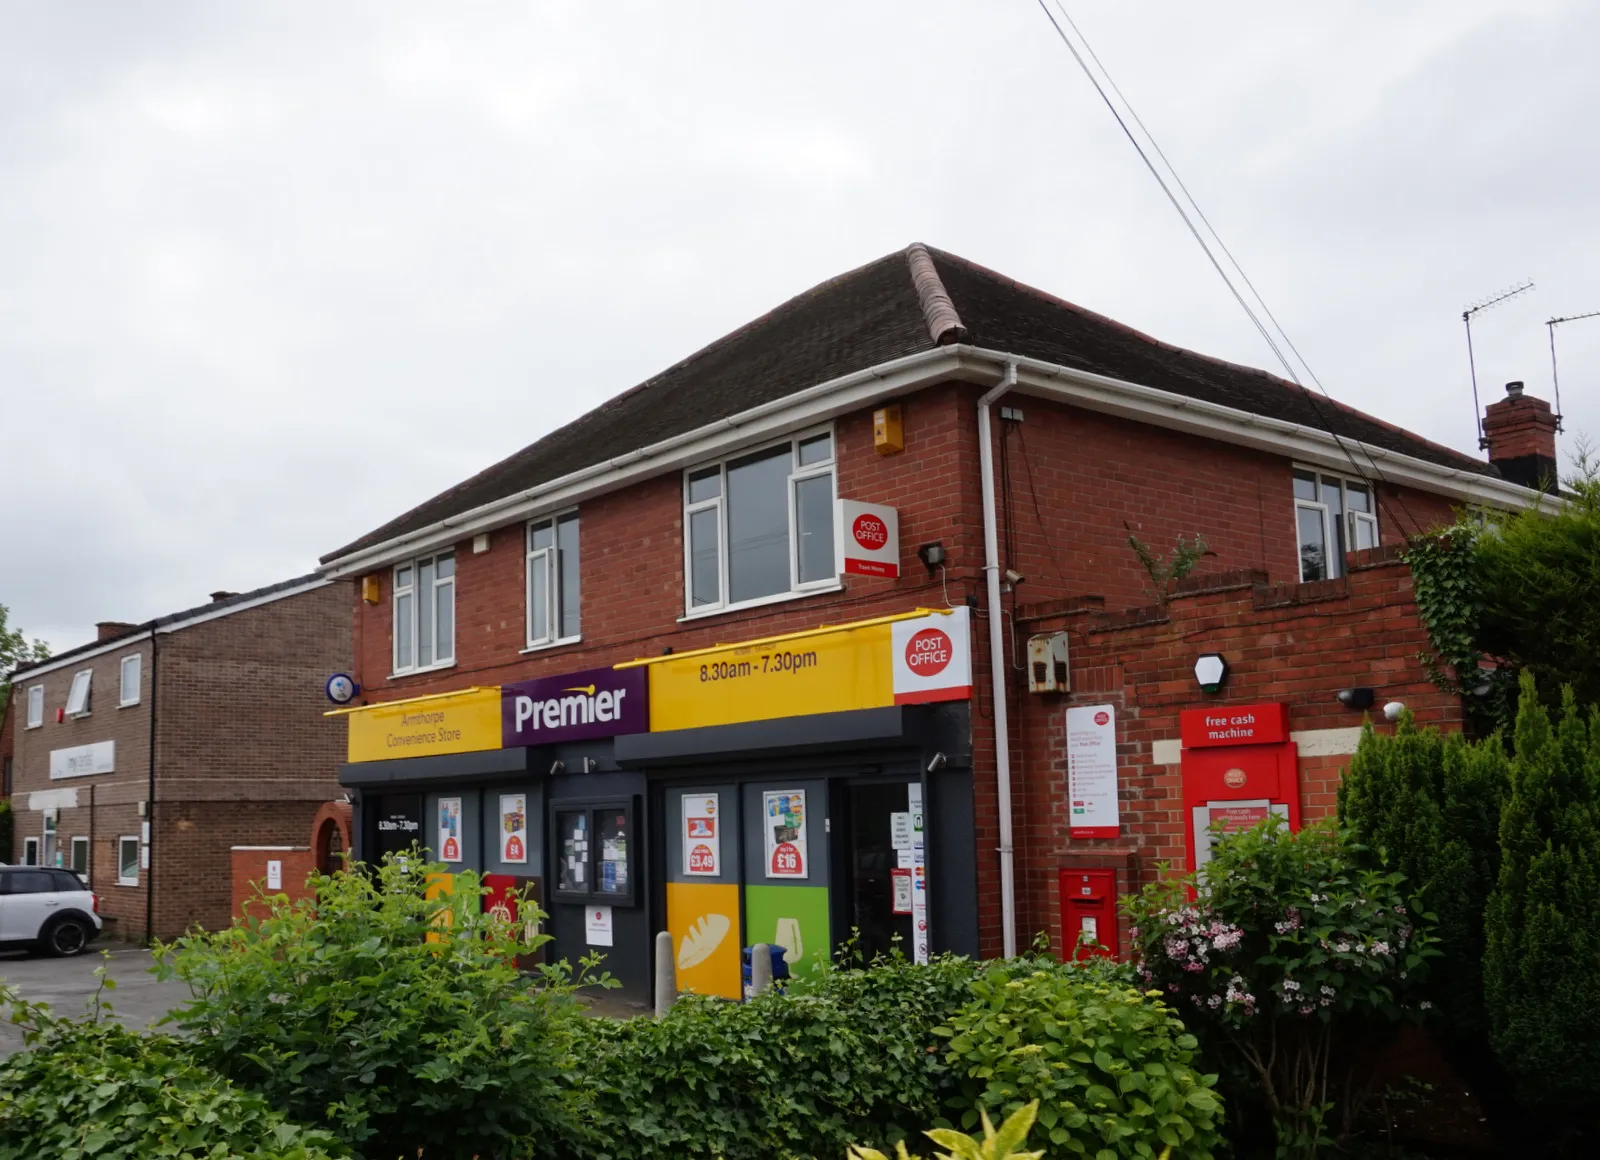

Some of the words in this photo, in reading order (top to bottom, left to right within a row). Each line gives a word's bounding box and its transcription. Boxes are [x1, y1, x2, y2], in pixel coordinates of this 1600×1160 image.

[860, 520, 880, 532] POST
[855, 530, 884, 543] OFFICE
[915, 636, 943, 652] POST
[909, 649, 948, 666] OFFICE
[699, 661, 751, 683] 8.30am
[761, 651, 817, 675] 7.30pm
[515, 684, 627, 732] Premier
[401, 711, 445, 728] Armthorpe
[1205, 715, 1227, 727] free
[1230, 713, 1255, 725] cash
[386, 731, 436, 748] Convenience
[438, 727, 461, 742] Store
[1208, 727, 1254, 740] machine
[690, 854, 713, 868] £3.49
[778, 854, 796, 868] £16
